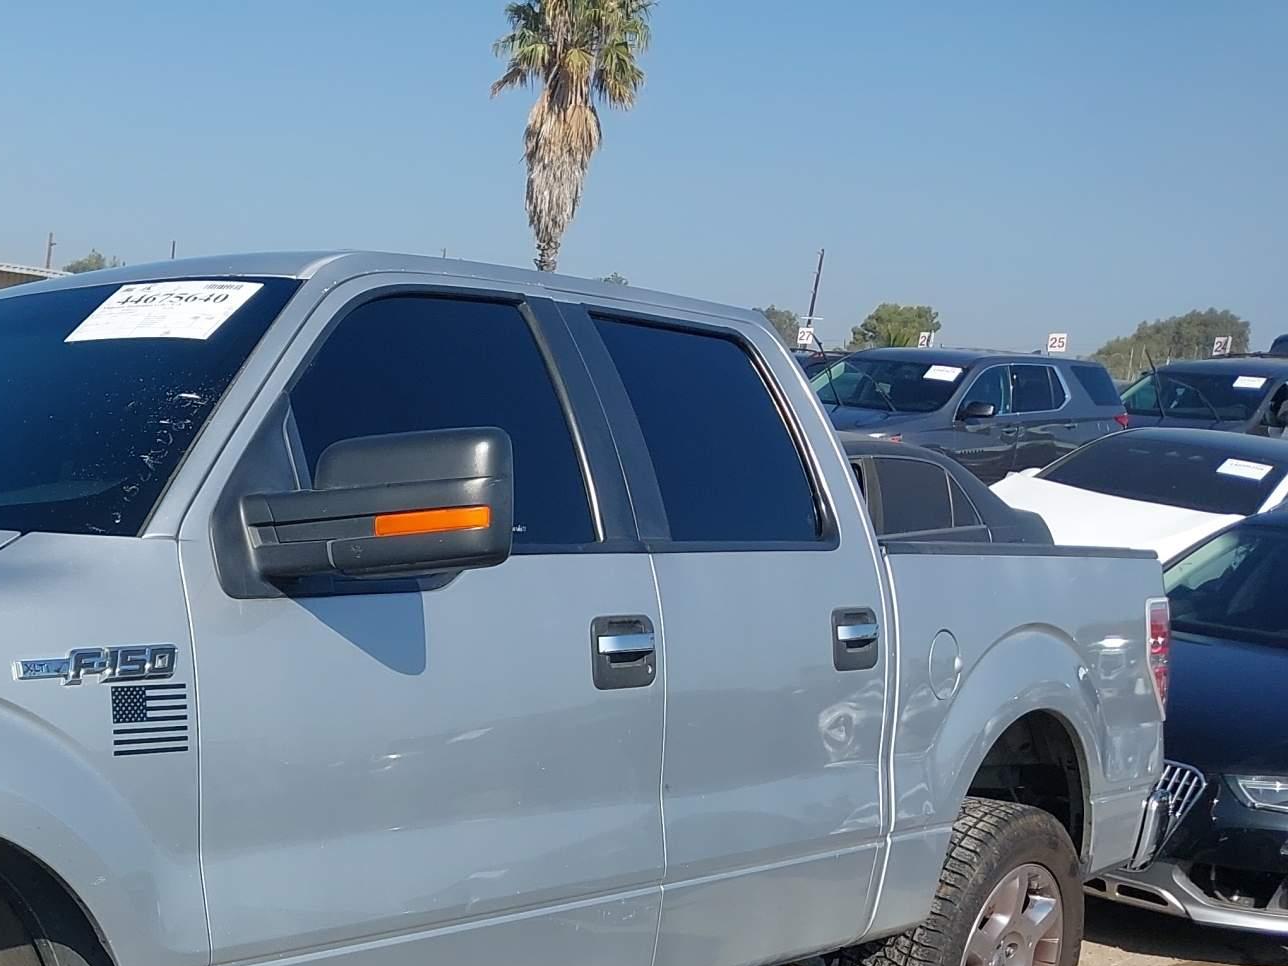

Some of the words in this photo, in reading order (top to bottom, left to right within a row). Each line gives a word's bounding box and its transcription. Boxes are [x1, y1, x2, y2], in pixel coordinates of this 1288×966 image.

[117, 292, 230, 305] 44675640
[798, 330, 812, 341] 27
[1049, 336, 1065, 348] 25
